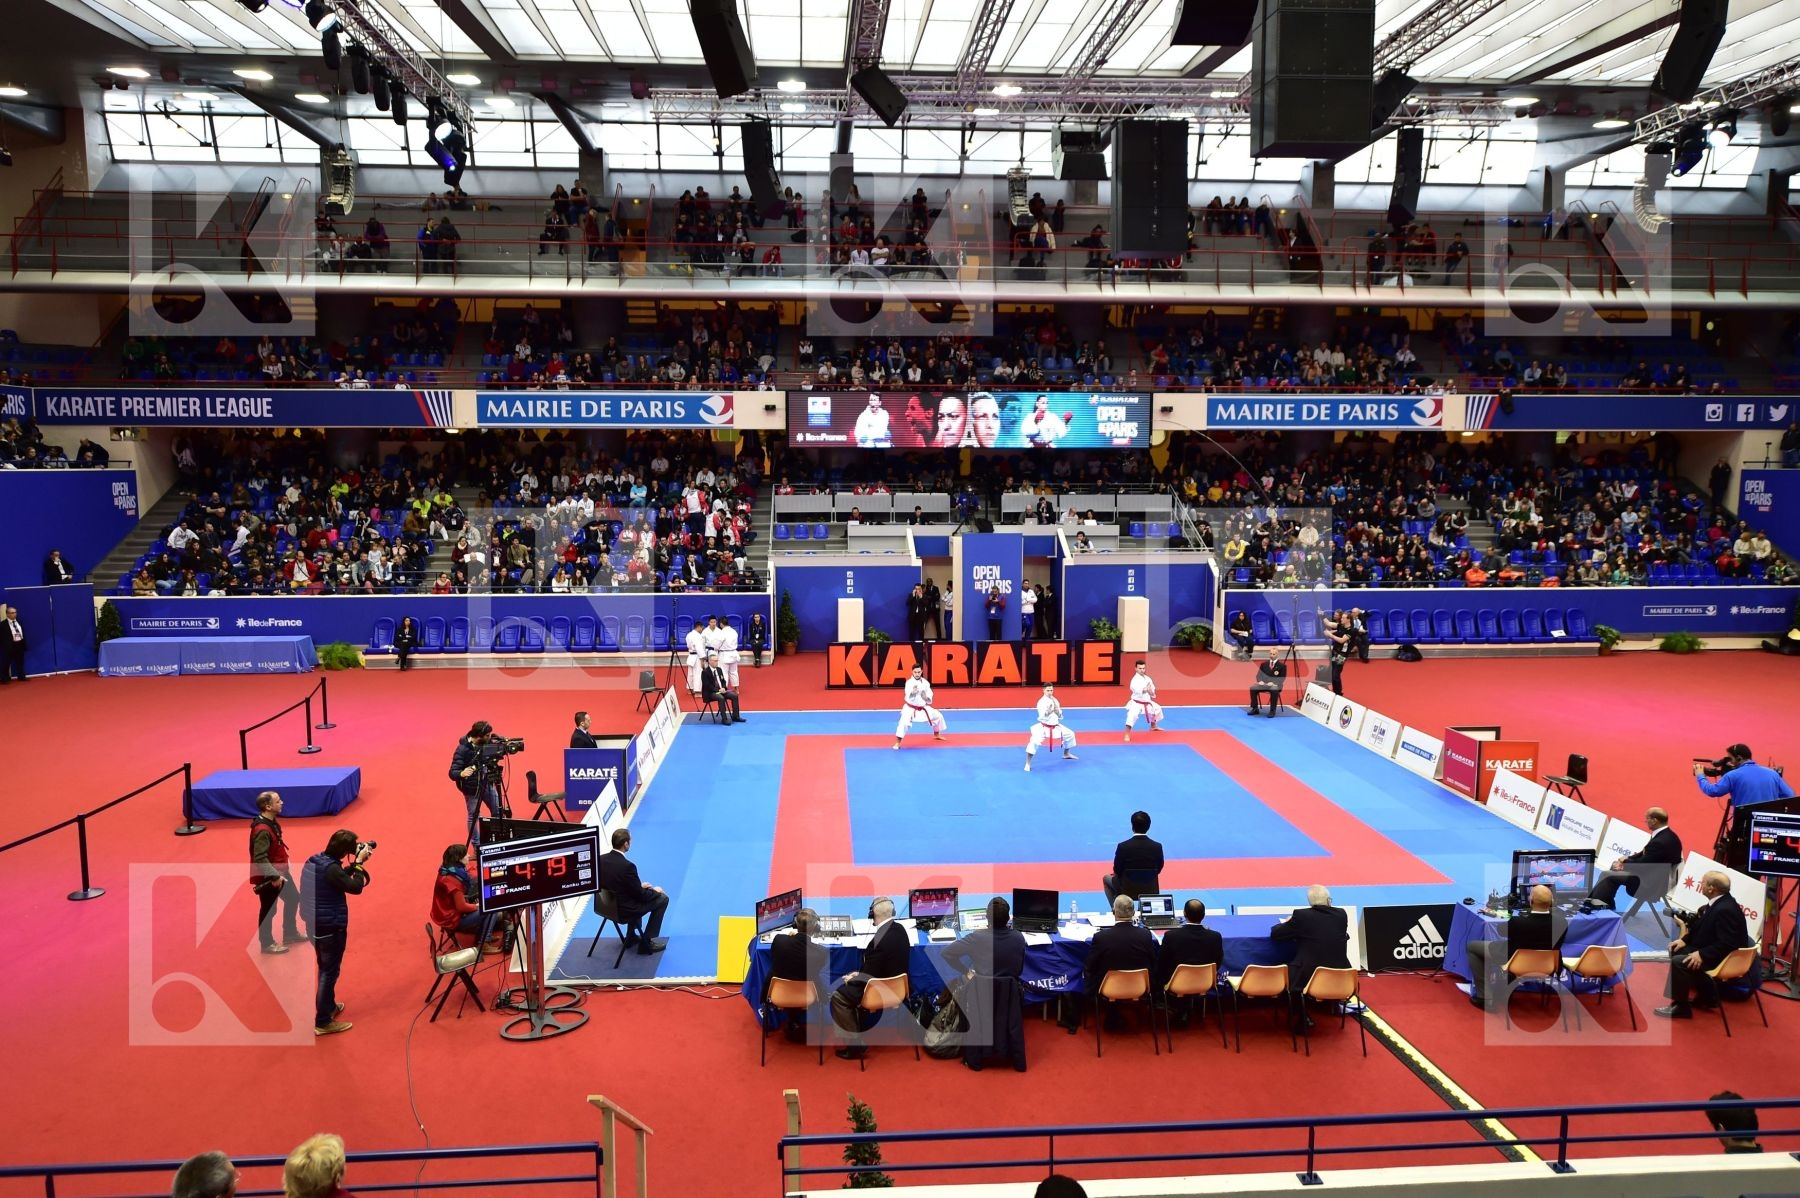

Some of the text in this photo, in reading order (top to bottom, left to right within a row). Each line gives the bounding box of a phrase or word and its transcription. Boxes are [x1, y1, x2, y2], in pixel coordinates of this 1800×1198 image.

[0, 394, 26, 416] ARIS
[46, 397, 273, 418] KARATE PREMIER LEAGUE
[487, 400, 686, 418] MAIRIE DE PARIS
[1216, 403, 1399, 421] MAIRIE DE PARIS
[112, 482, 129, 496] OPEN
[1744, 480, 1765, 492] OPEN
[119, 496, 137, 509] PARIS
[1750, 493, 1773, 506] PARIS
[973, 565, 1000, 580] OPEN
[974, 580, 1012, 594] DE PARIS
[829, 642, 1114, 686] KARATE
[1485, 758, 1534, 769] KARATÉ
[569, 766, 618, 777] KARATÉ
[505, 885, 531, 894] FRANCE
